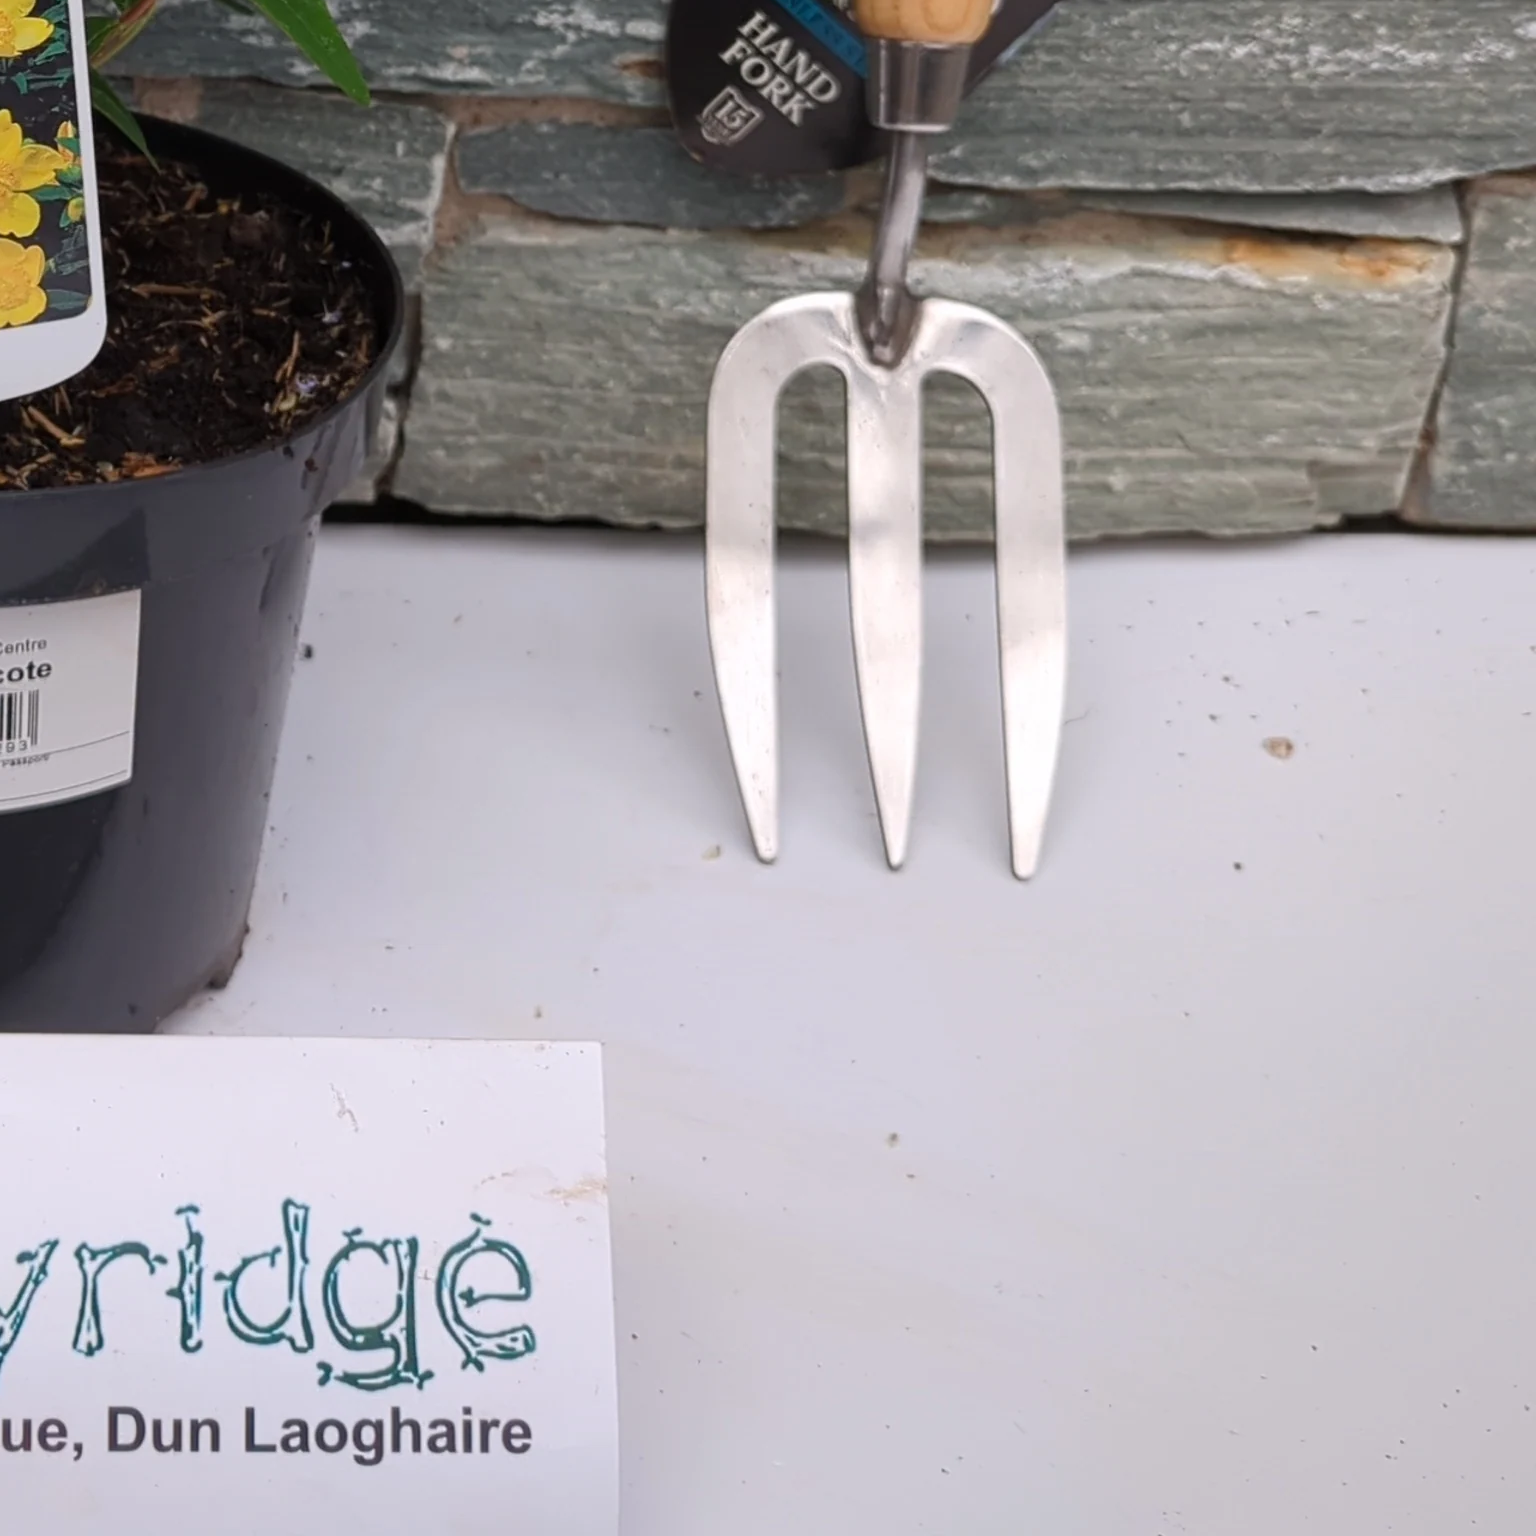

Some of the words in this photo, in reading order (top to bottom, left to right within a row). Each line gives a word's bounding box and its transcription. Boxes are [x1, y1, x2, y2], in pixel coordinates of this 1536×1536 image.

[718, 36, 817, 128] FORK
[736, 9, 842, 104] HAND
[715, 99, 747, 131] 15
[106, 1405, 221, 1454] Dun
[244, 1405, 533, 1465] Laoghaire
